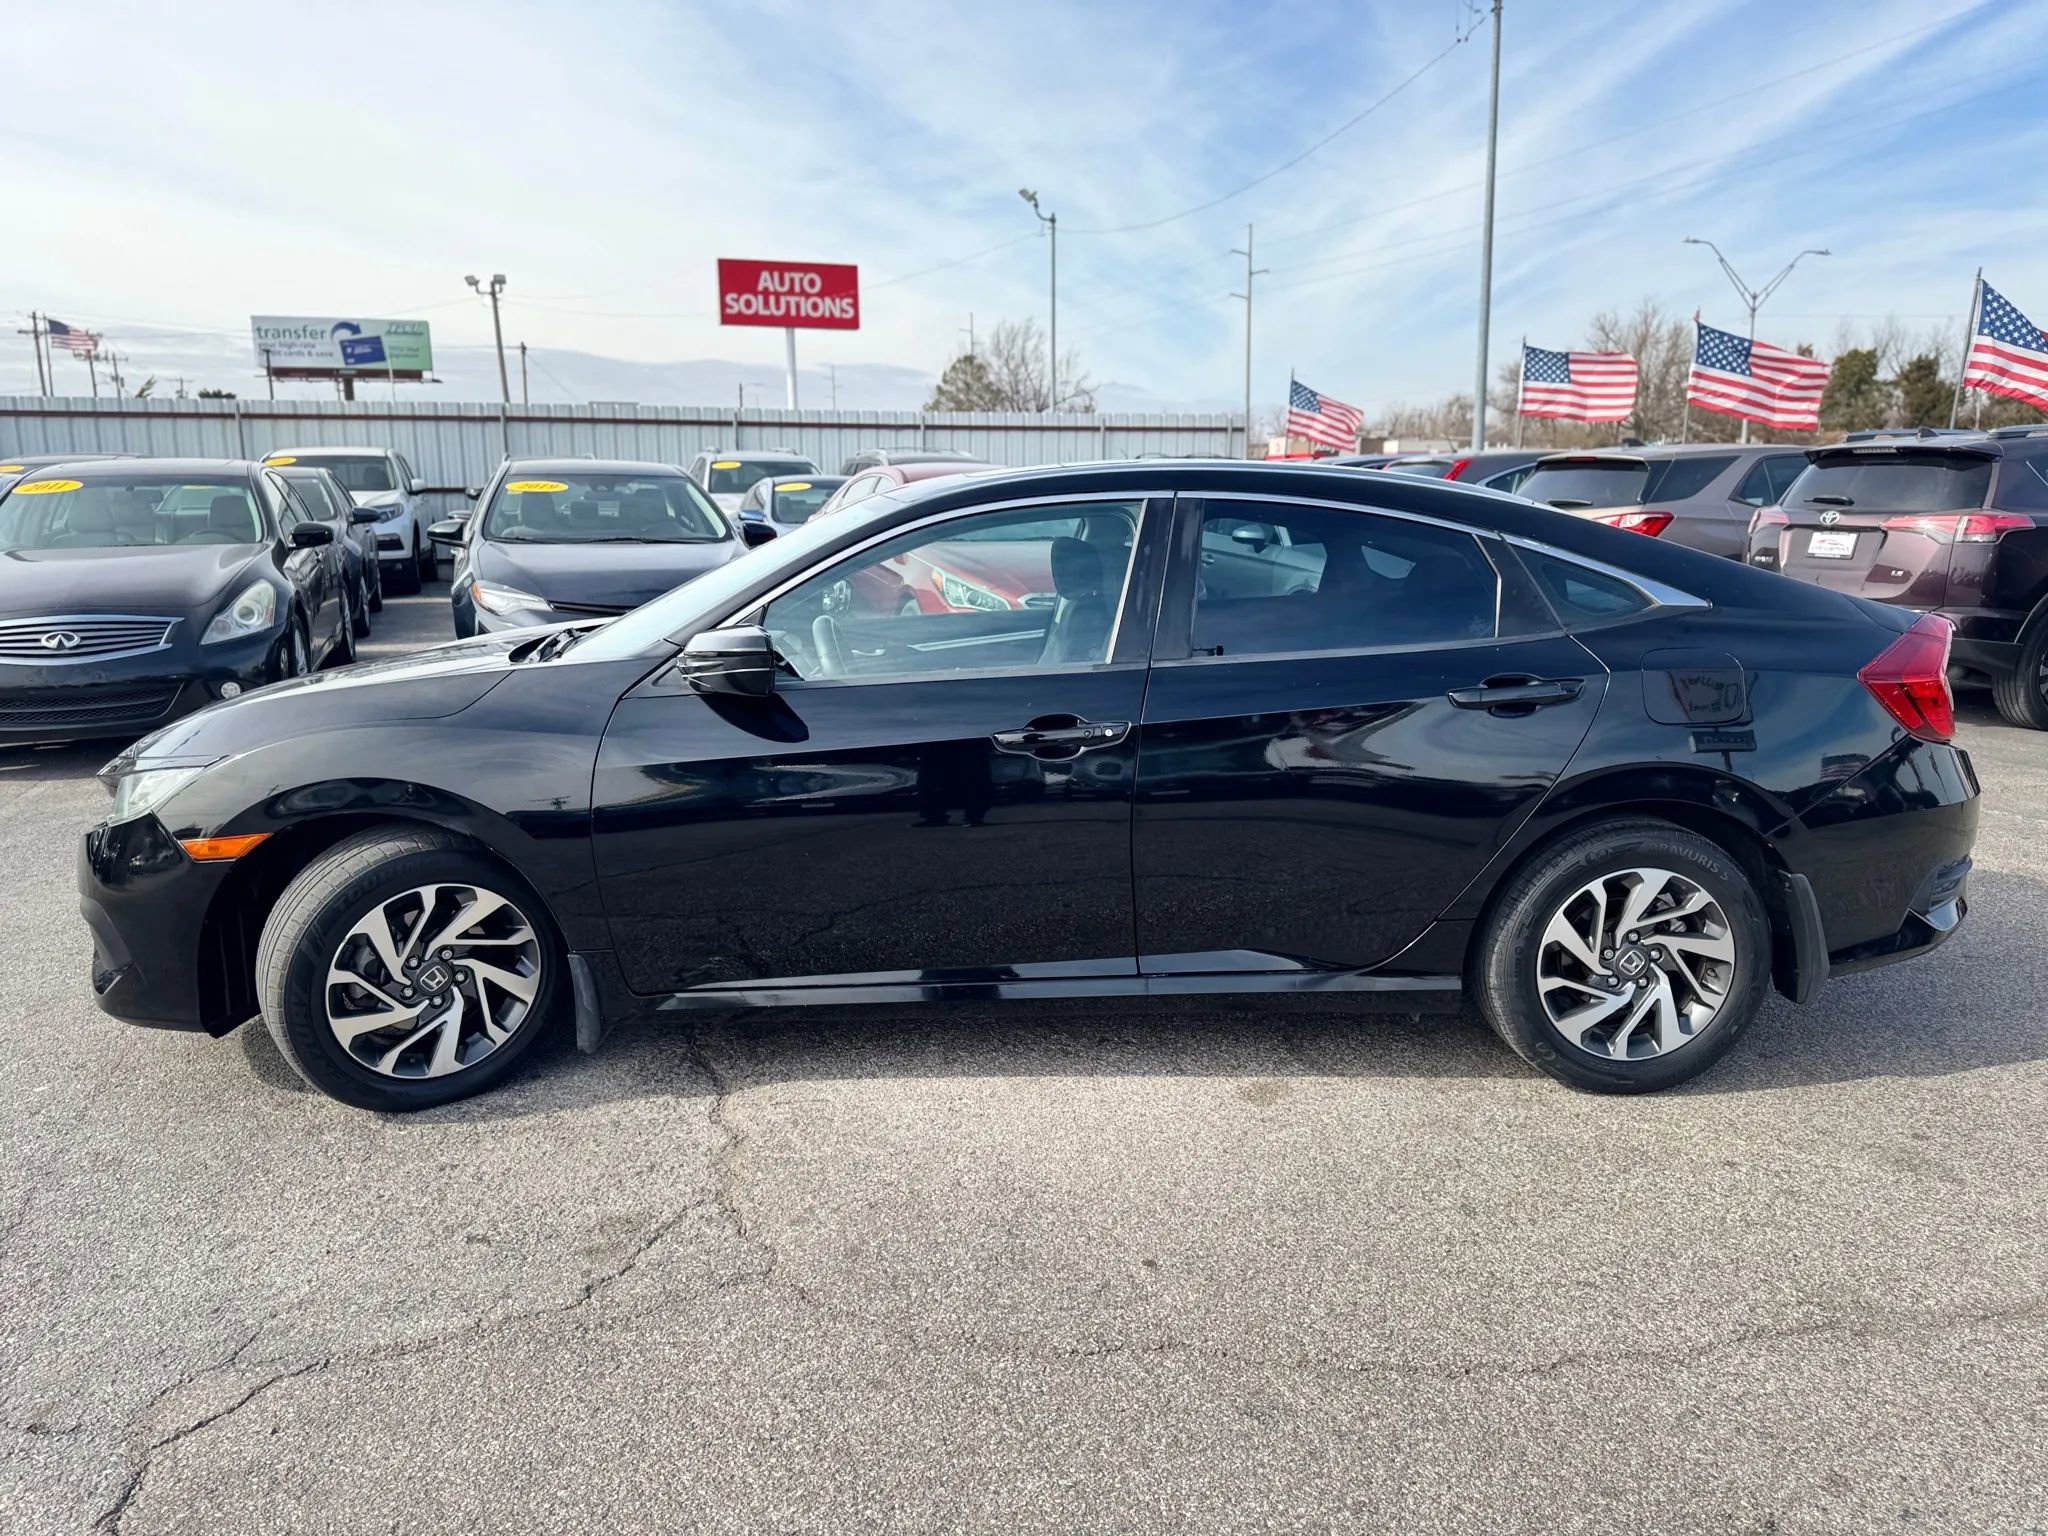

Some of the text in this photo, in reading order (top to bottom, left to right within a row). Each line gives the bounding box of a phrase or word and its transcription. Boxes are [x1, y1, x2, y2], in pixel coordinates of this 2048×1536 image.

[757, 270, 822, 294] AUTO
[725, 292, 855, 319] SOLUTIONS
[257, 325, 326, 340] transfer
